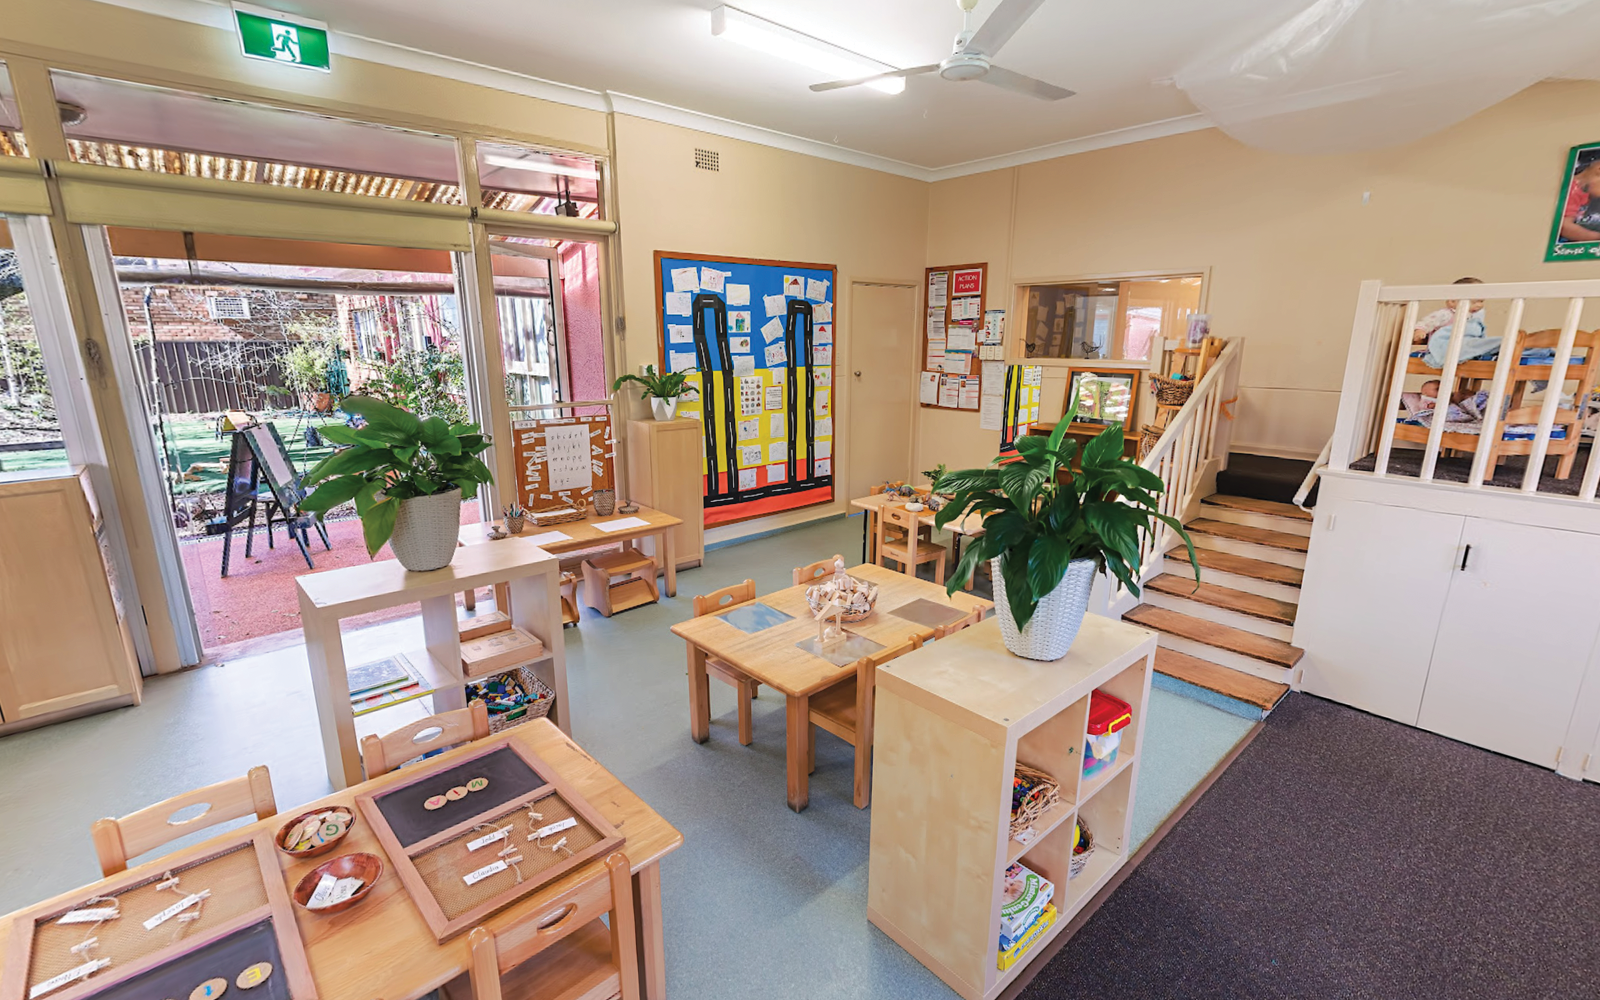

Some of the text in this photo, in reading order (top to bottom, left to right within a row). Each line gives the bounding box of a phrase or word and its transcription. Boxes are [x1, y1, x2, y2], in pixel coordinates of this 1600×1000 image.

[957, 274, 978, 282] ACTION
[959, 282, 975, 290] PLANS
[472, 865, 499, 880] Claudia
[1024, 877, 1039, 901] Mister
[154, 901, 186, 921] Joseph
